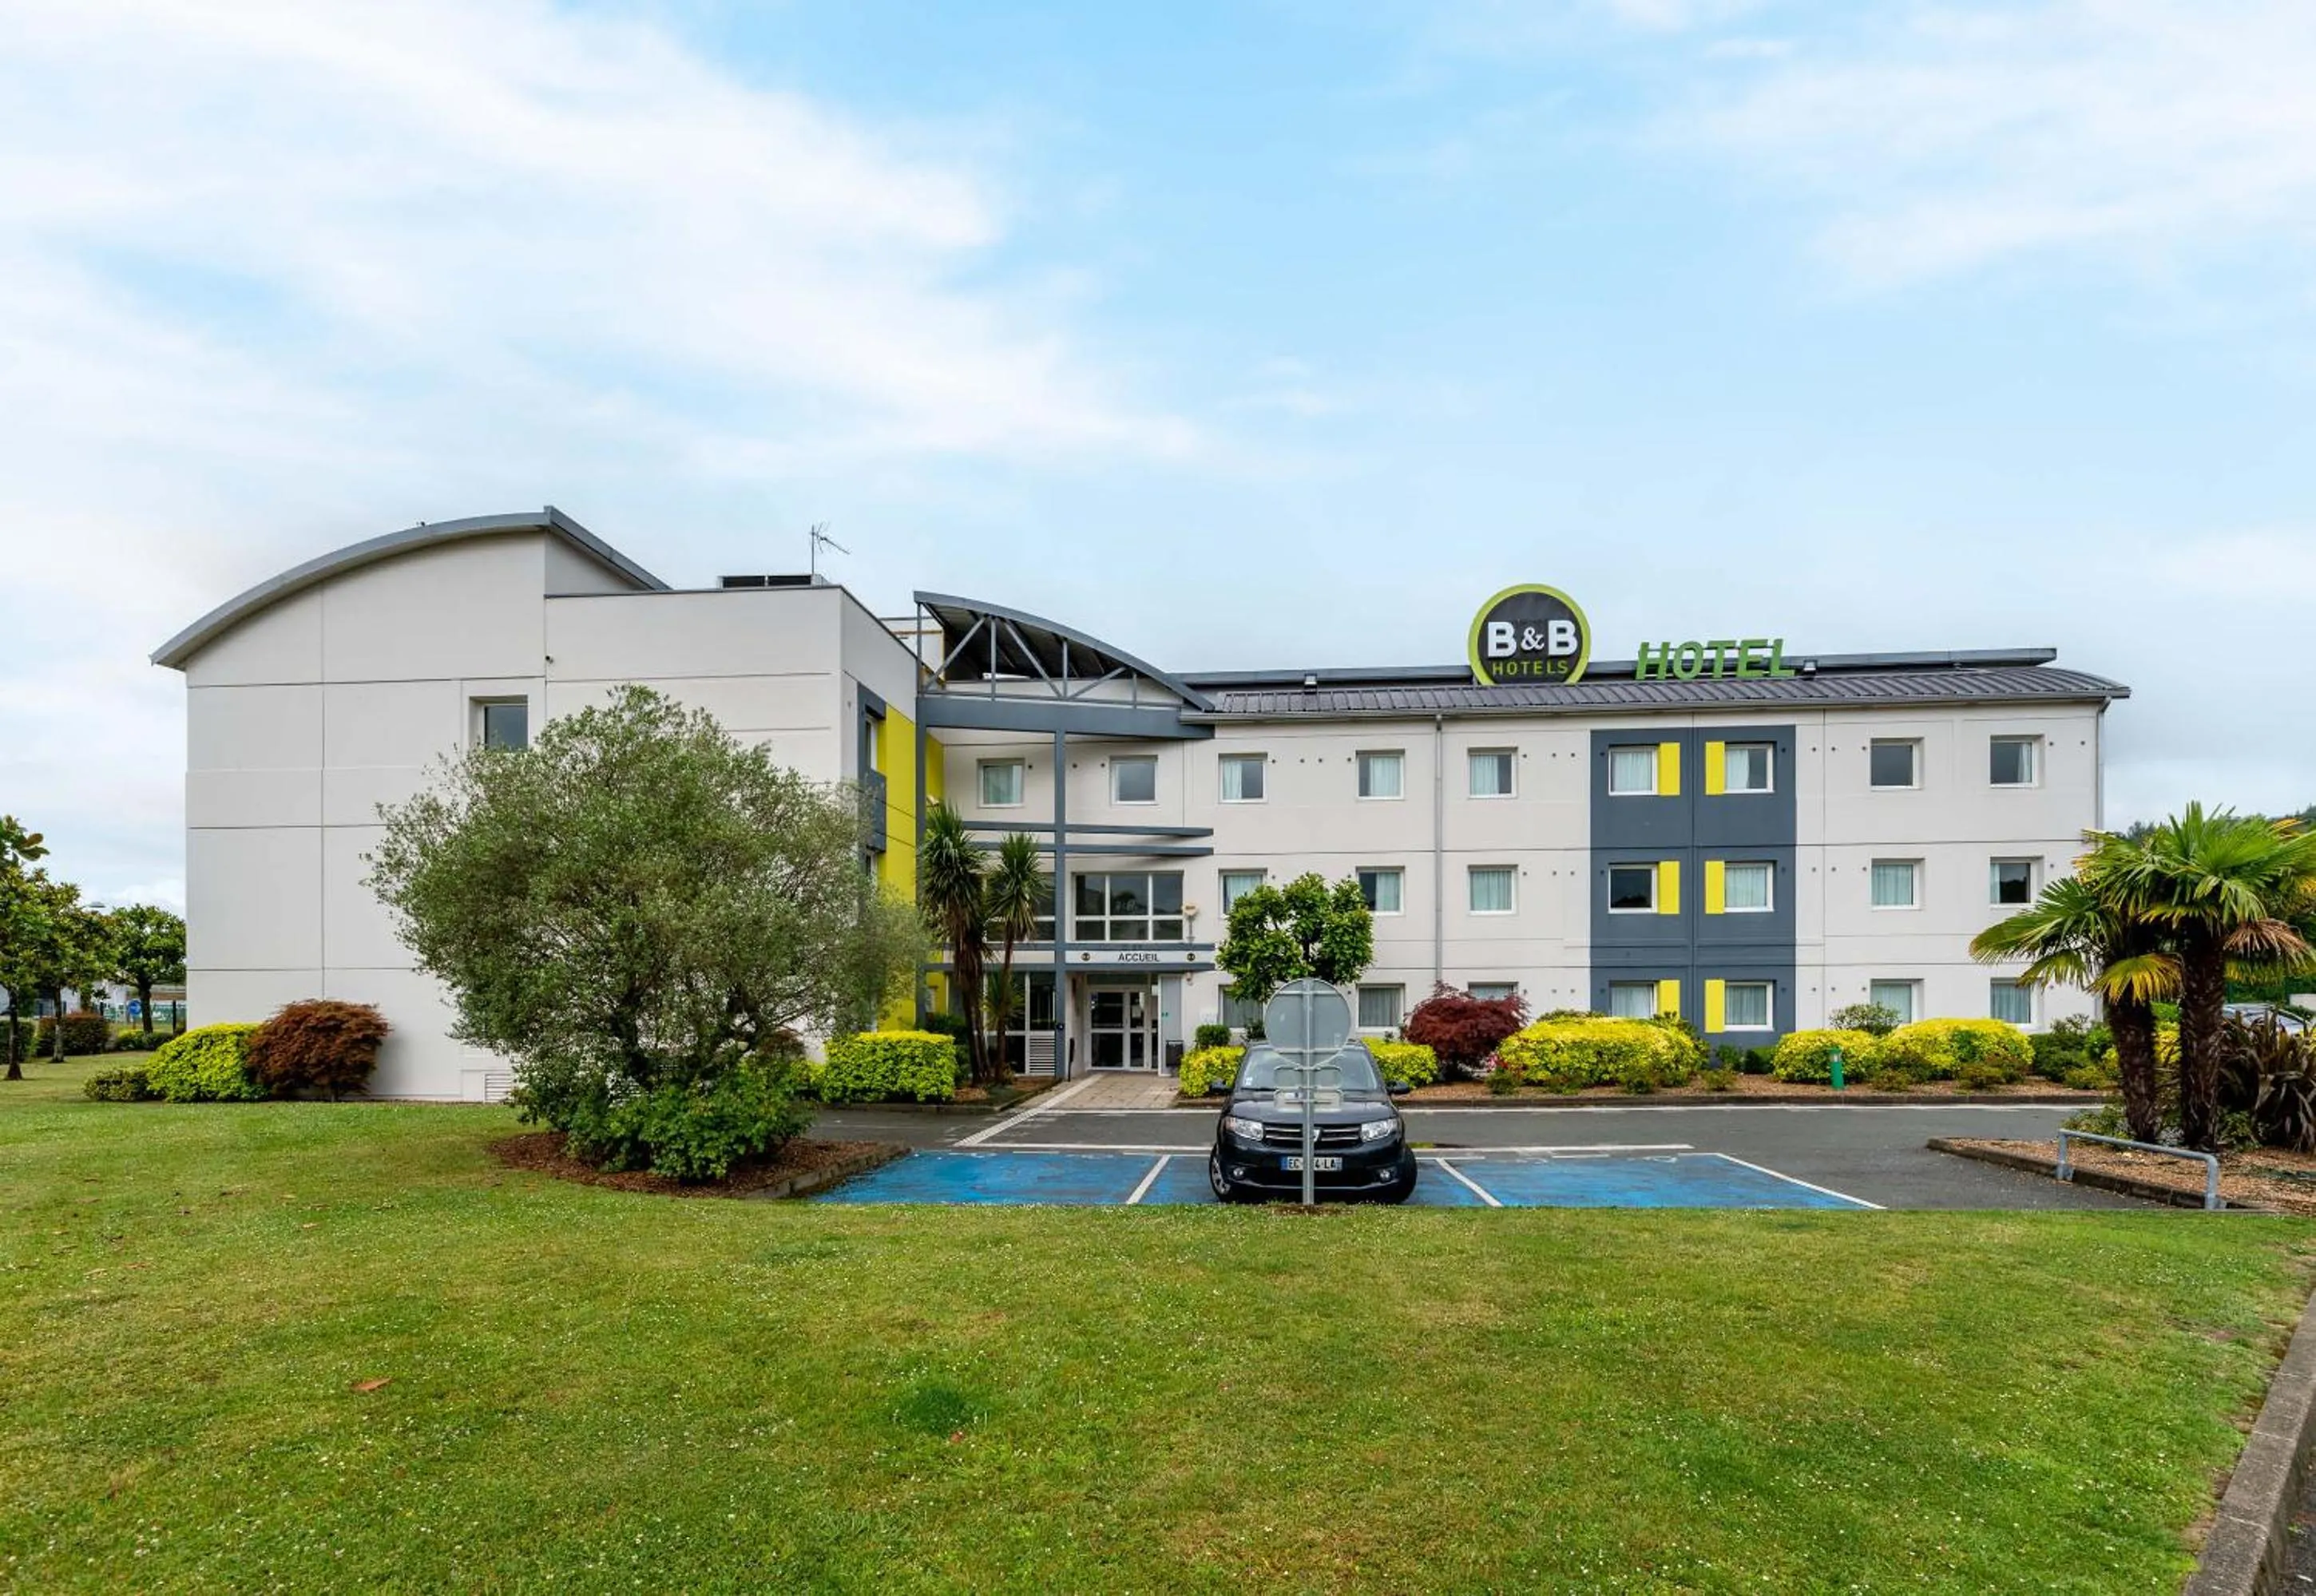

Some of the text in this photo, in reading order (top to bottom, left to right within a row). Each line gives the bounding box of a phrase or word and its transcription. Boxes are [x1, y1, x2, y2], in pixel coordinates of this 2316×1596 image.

[1488, 620, 1577, 657] B&B
[1492, 659, 1568, 676] HOTELS
[1636, 639, 1795, 680] HOTEL
[1118, 952, 1160, 962] ACCUEIL
